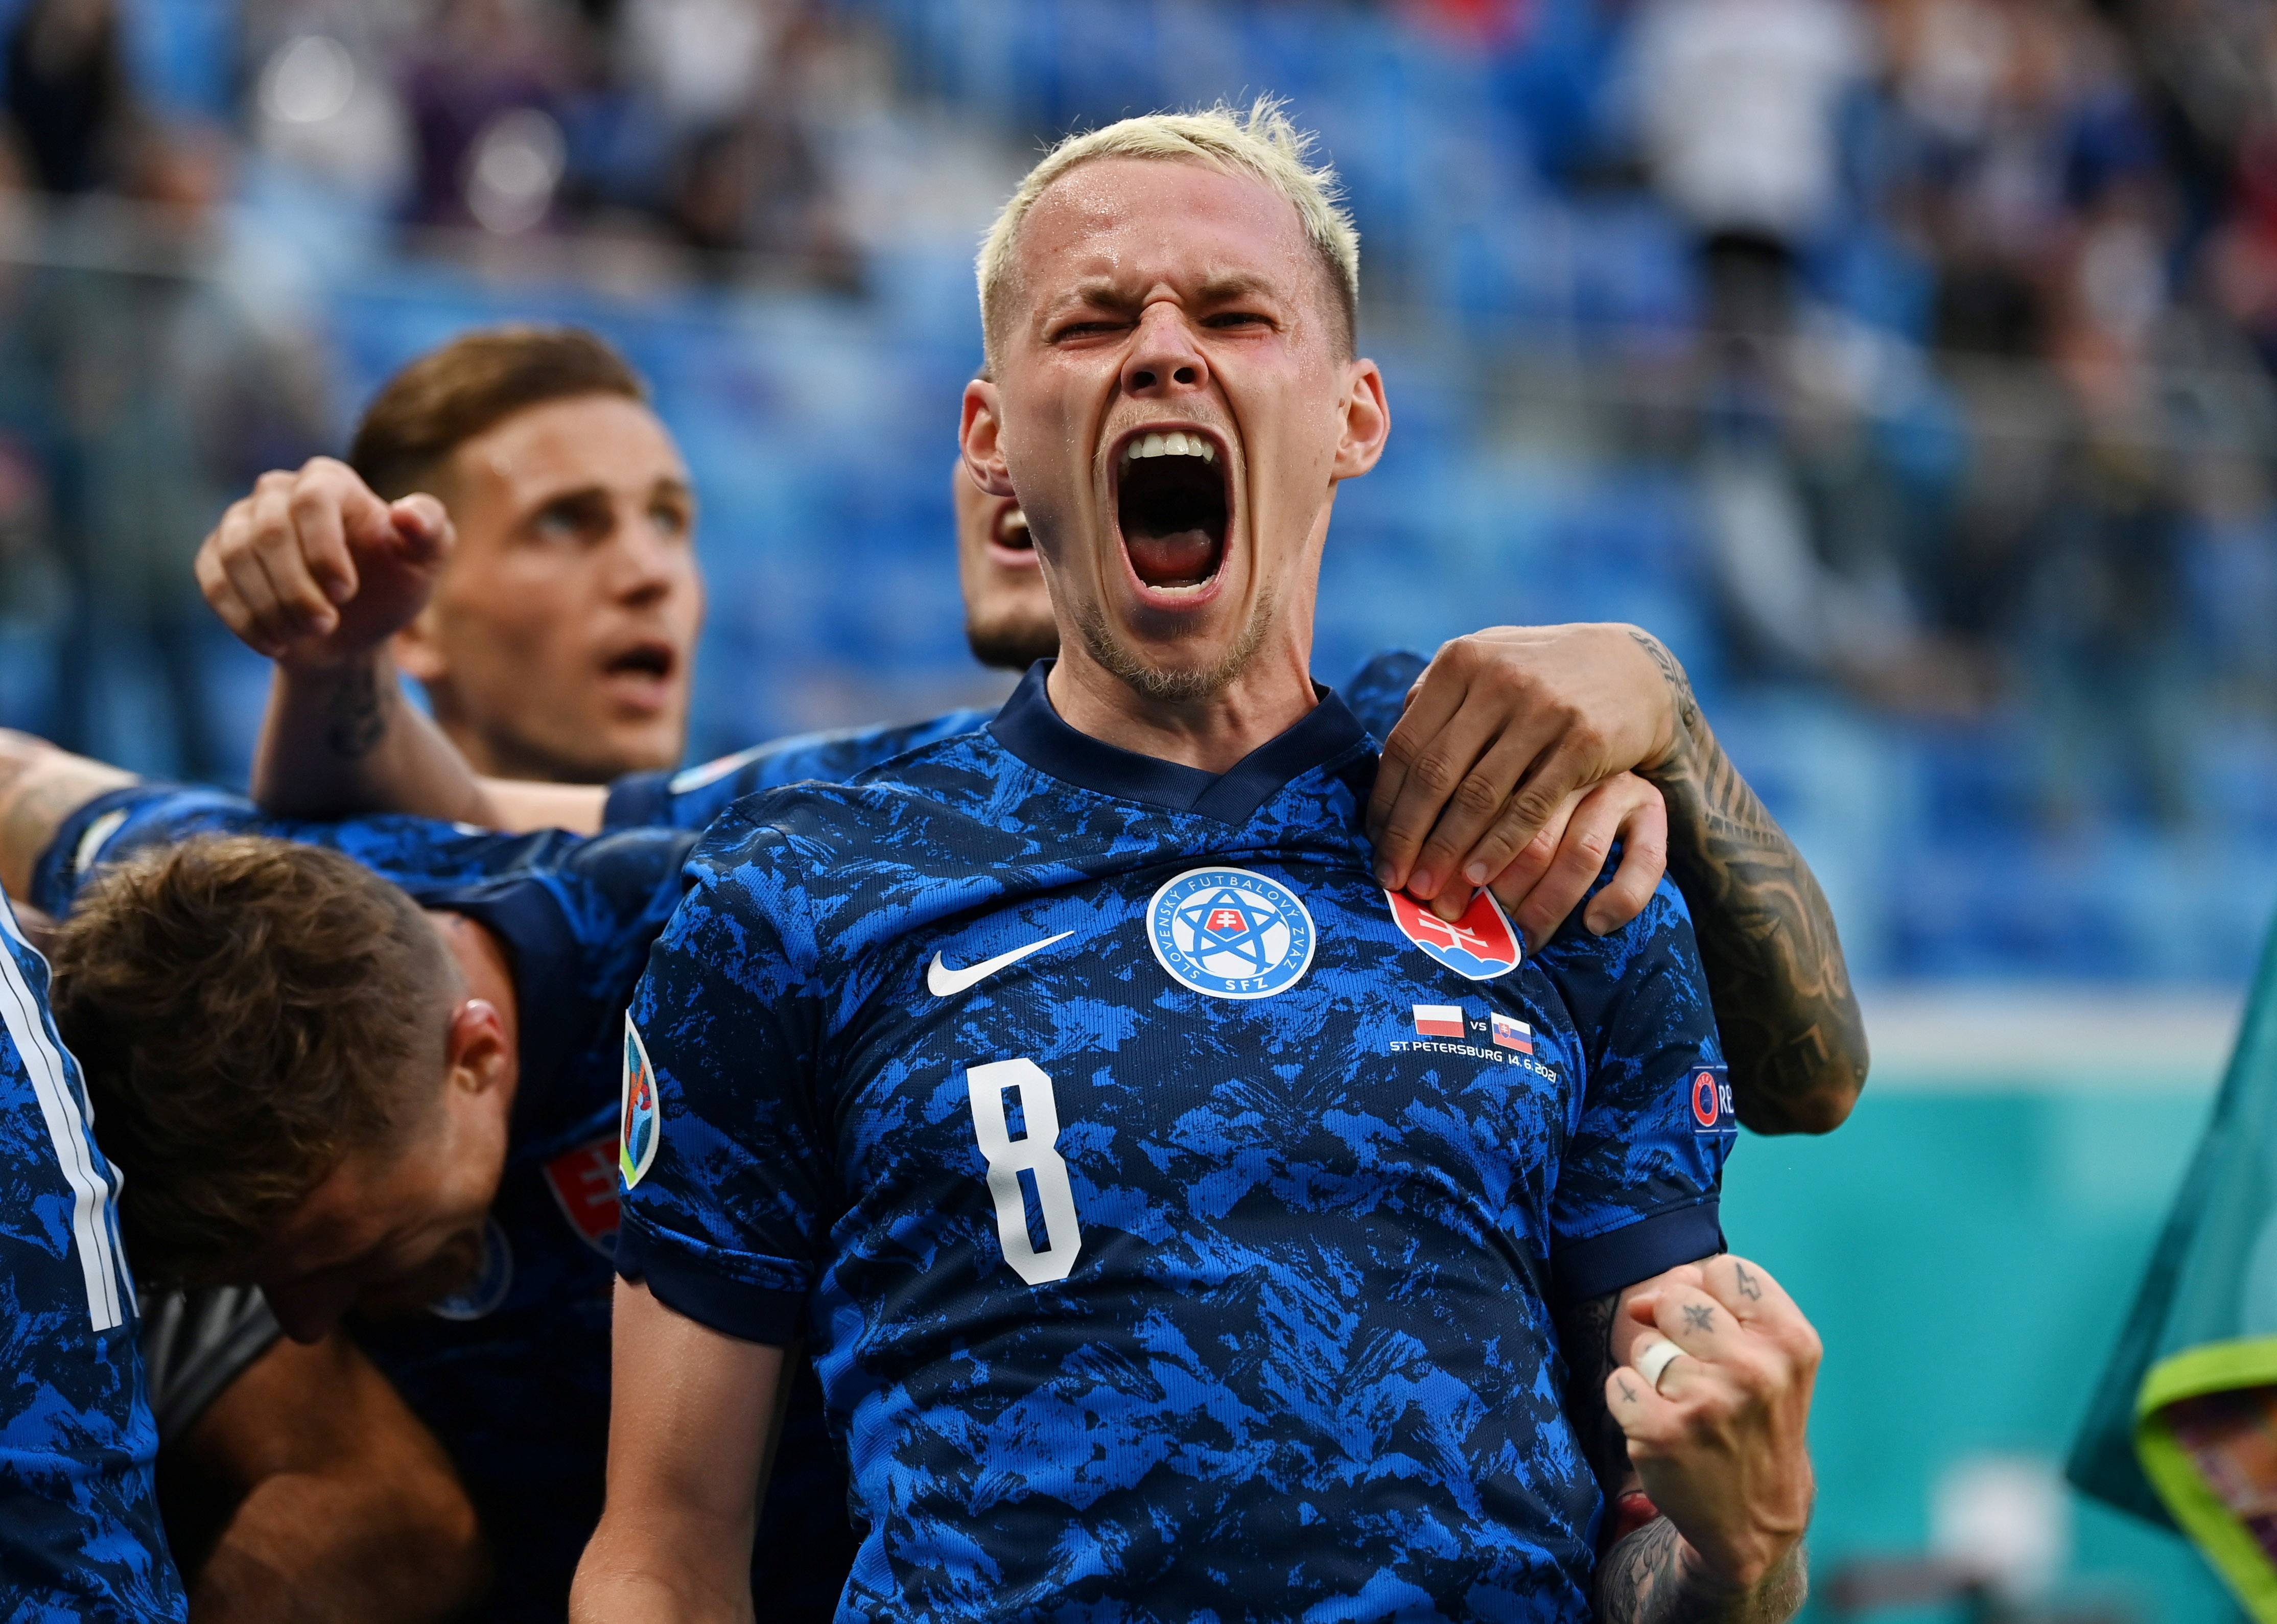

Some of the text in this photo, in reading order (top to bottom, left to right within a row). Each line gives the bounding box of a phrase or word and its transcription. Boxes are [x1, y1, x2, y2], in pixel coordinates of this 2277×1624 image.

[1159, 875, 1305, 979] SLOVENSKÝ FUTBALOVÝ ZVÄZ
[1225, 978, 1269, 991] SFZ
[1390, 1041, 1410, 1051] ST.
[1413, 1041, 1503, 1062] PETERSBURG
[966, 1057, 1082, 1286] 8
